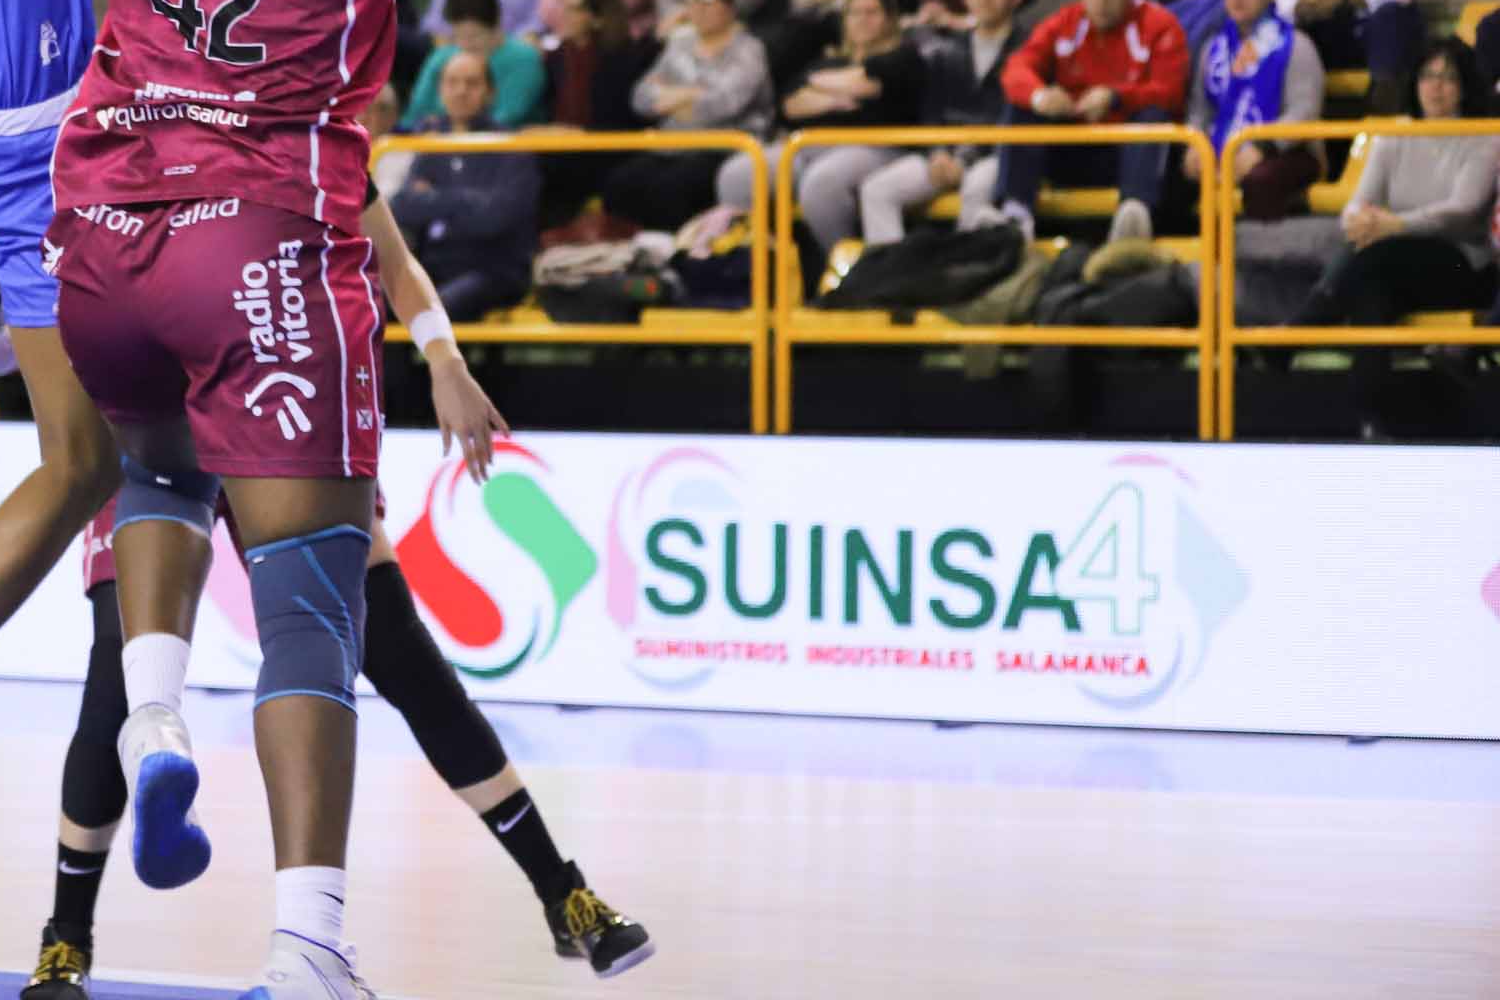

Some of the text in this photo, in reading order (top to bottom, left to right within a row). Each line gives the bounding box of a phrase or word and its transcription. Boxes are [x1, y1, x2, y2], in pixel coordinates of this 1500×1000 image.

[169, 198, 240, 236] alud
[232, 261, 280, 364] radio
[268, 239, 314, 363] vitoria
[995, 649, 1152, 677] SALAMANCA
